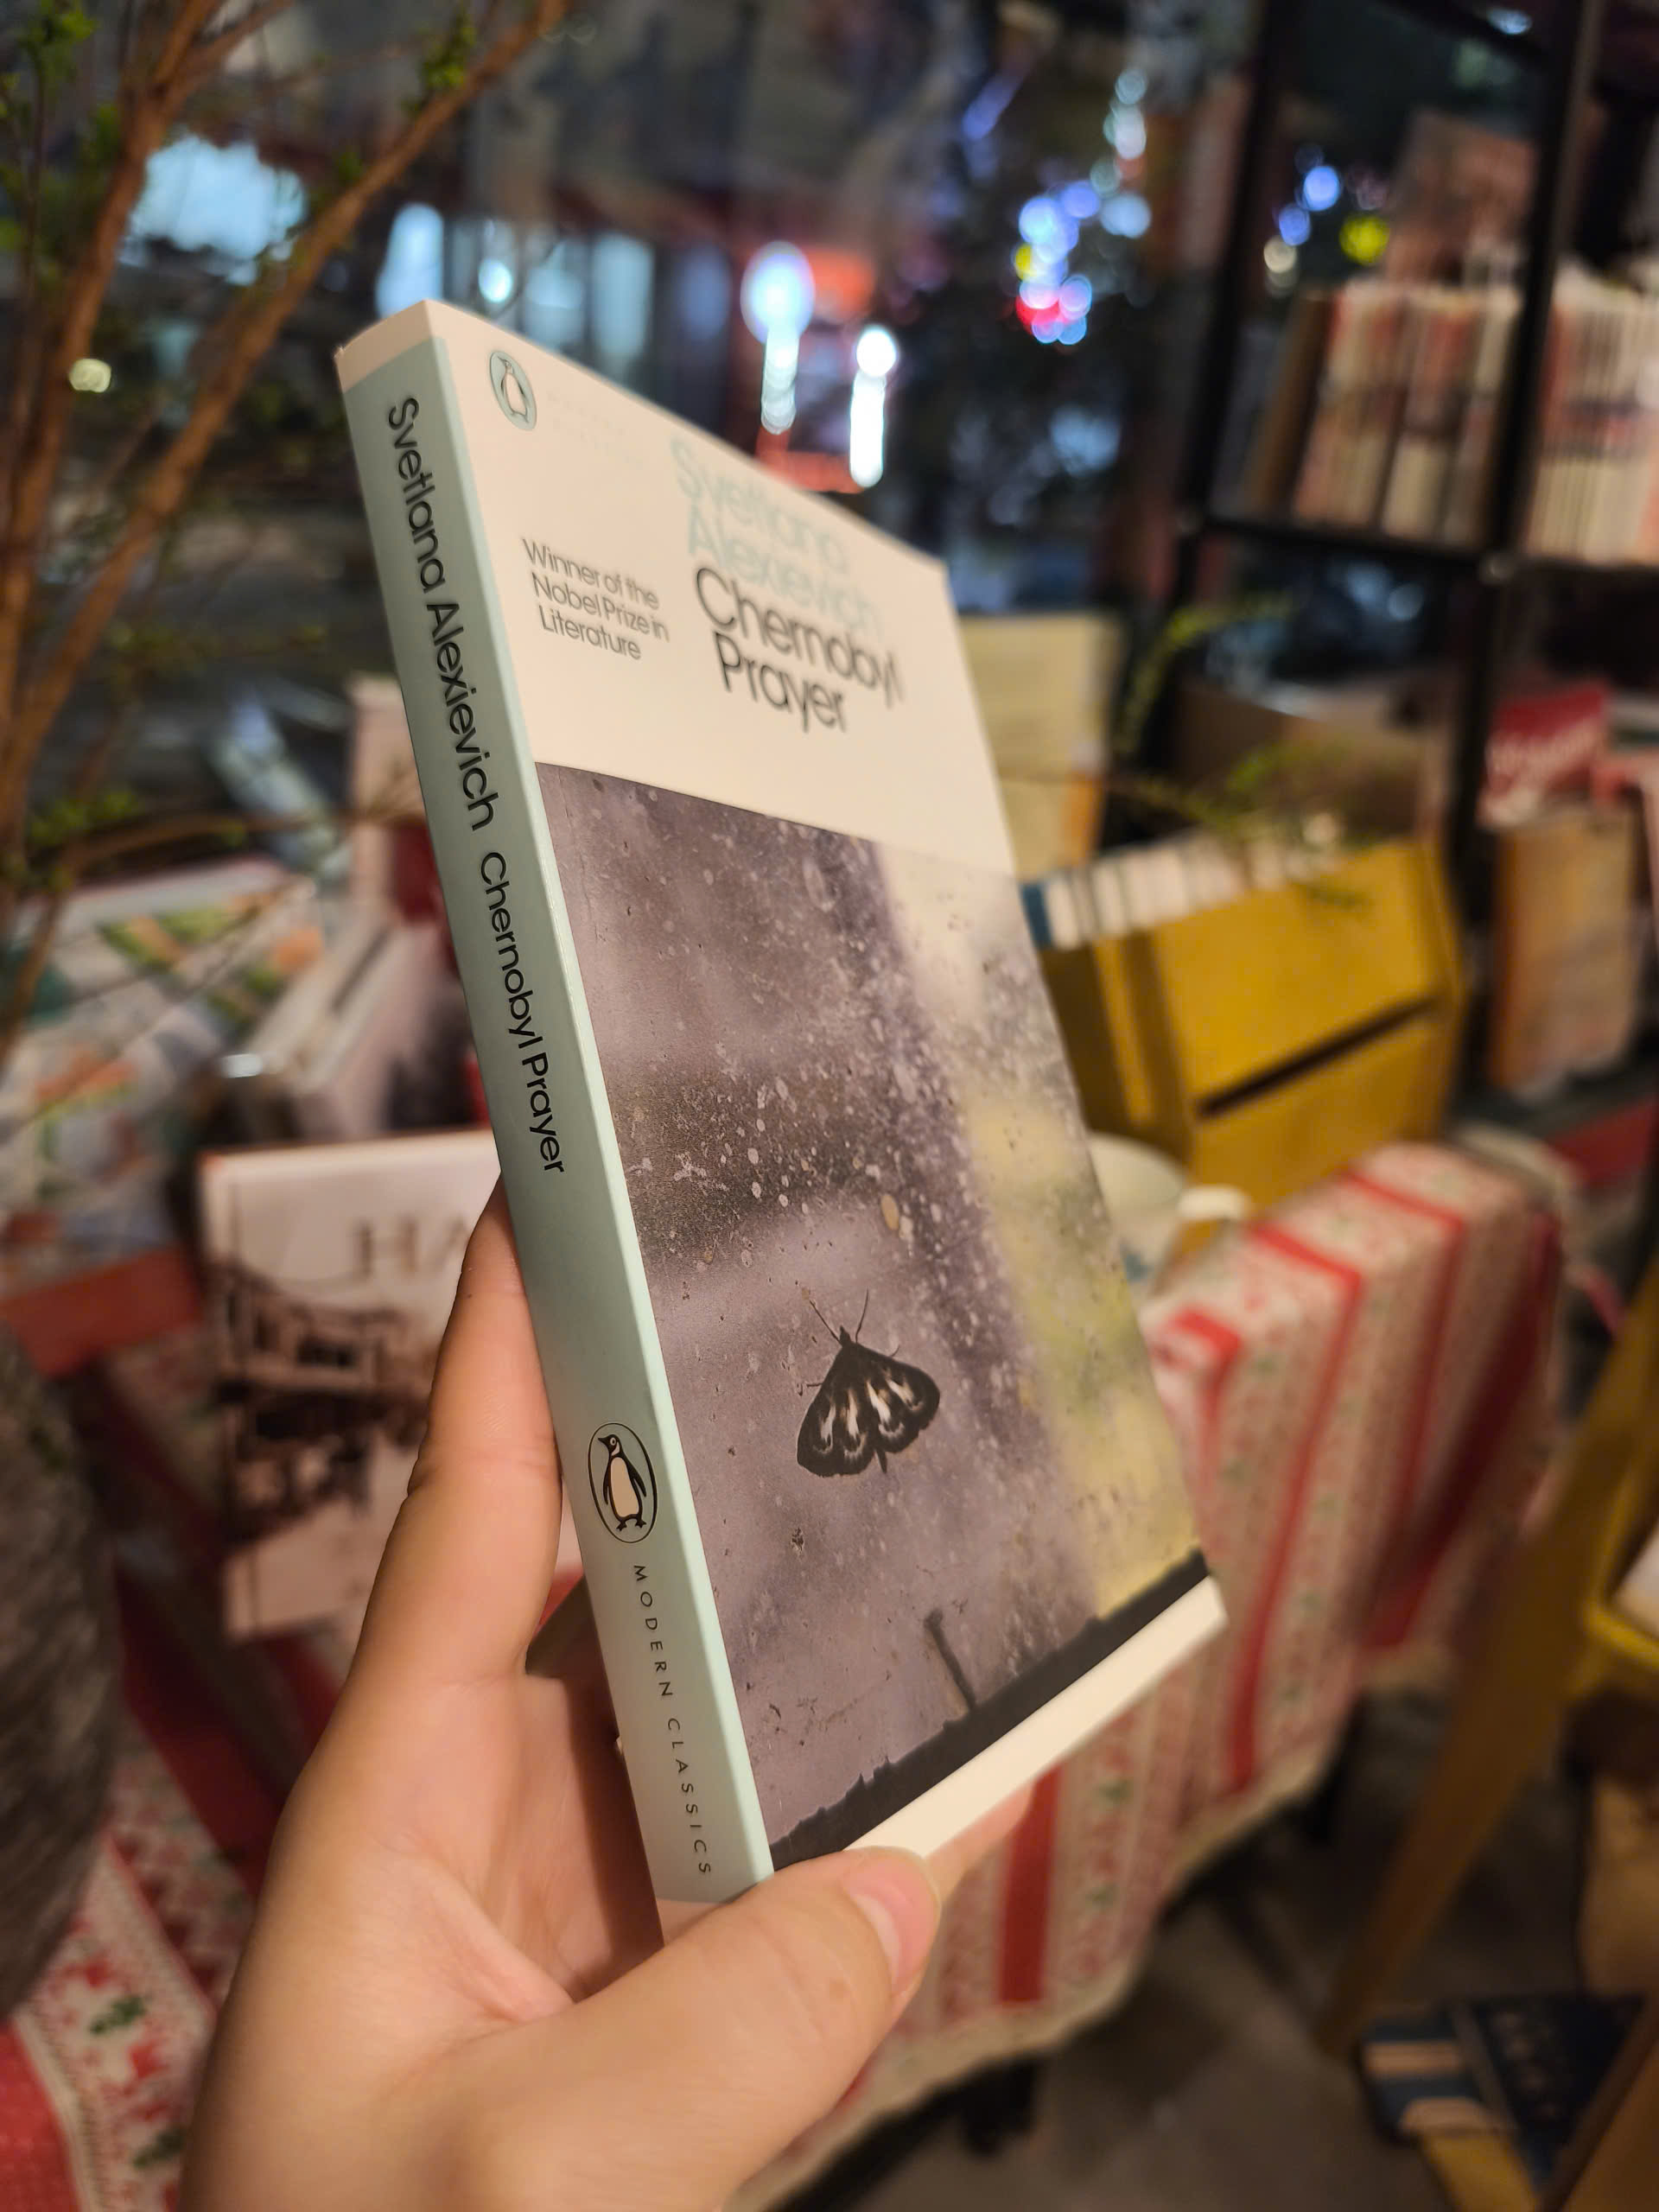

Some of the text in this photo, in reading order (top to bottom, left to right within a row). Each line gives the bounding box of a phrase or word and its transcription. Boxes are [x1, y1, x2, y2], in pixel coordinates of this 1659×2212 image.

[671, 435, 850, 574] Svetlana
[522, 538, 660, 611] Winner of the
[531, 571, 671, 644] Nobel Prize in
[538, 604, 641, 660] Literature
[696, 567, 904, 710] Chernobyl
[714, 629, 848, 734] Prayer
[388, 397, 565, 1173] Svetlana Alexievich Chernobyl Prayer
[633, 1564, 711, 1874] MODERN CLASSICS
